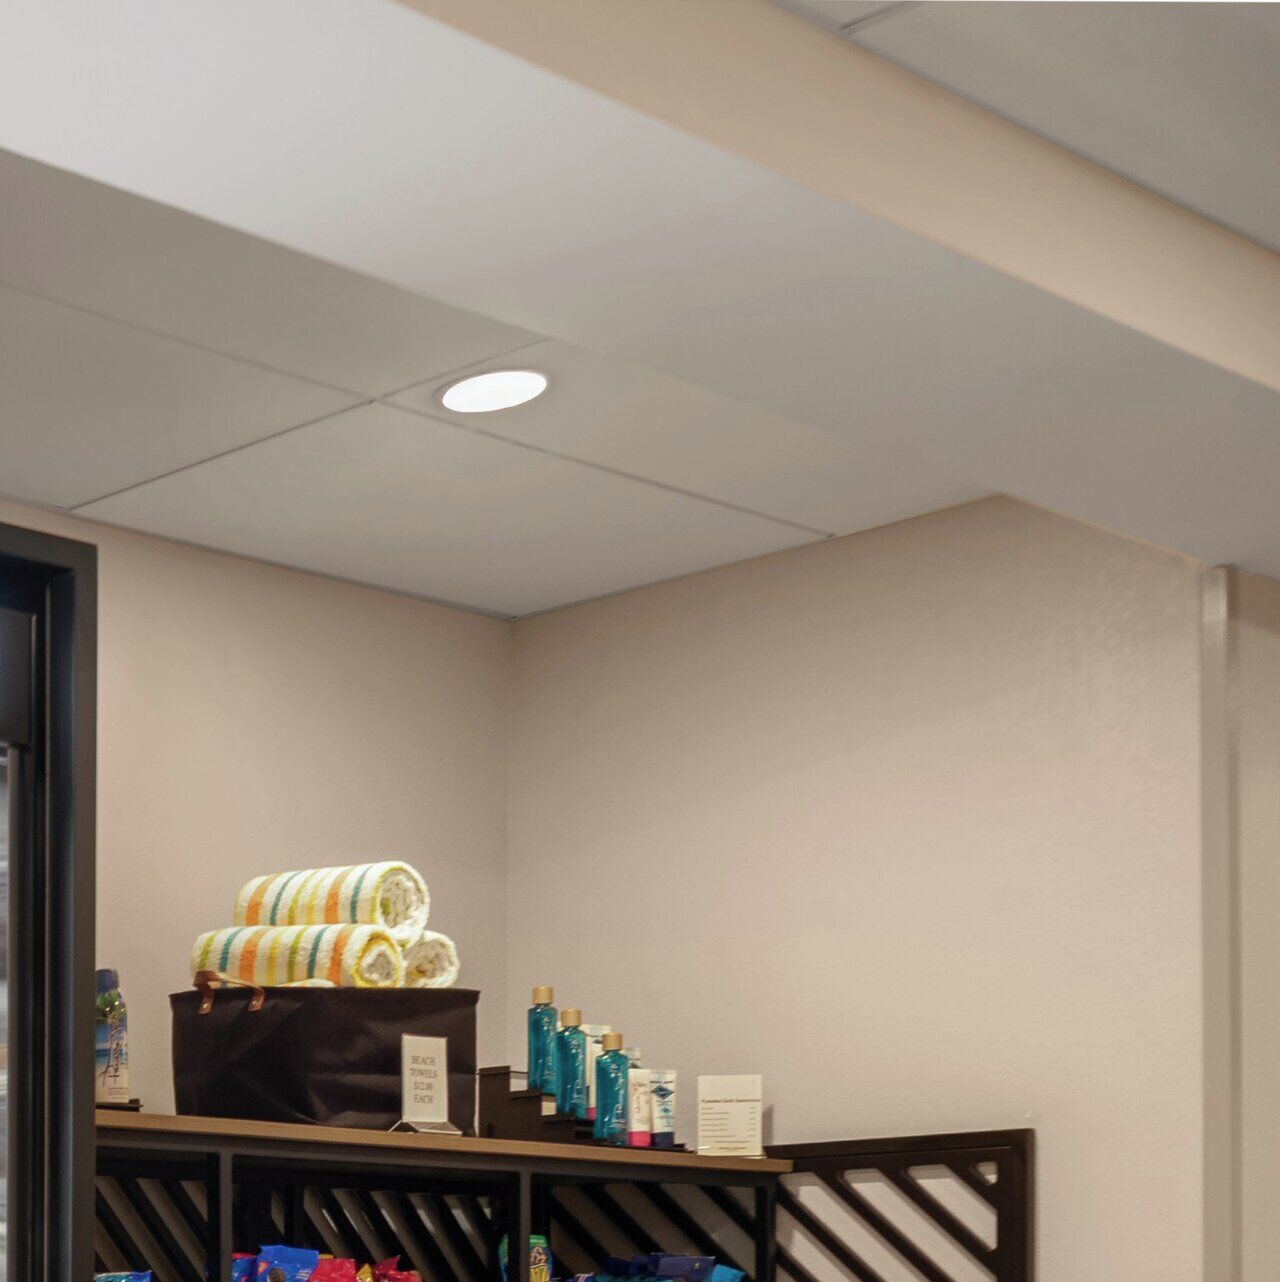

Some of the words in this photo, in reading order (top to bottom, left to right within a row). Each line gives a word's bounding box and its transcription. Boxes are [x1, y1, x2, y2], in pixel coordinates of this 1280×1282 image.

[411, 1055, 436, 1066] BEACH
[409, 1068, 438, 1080] TOWELS
[413, 1093, 434, 1105] EACH
